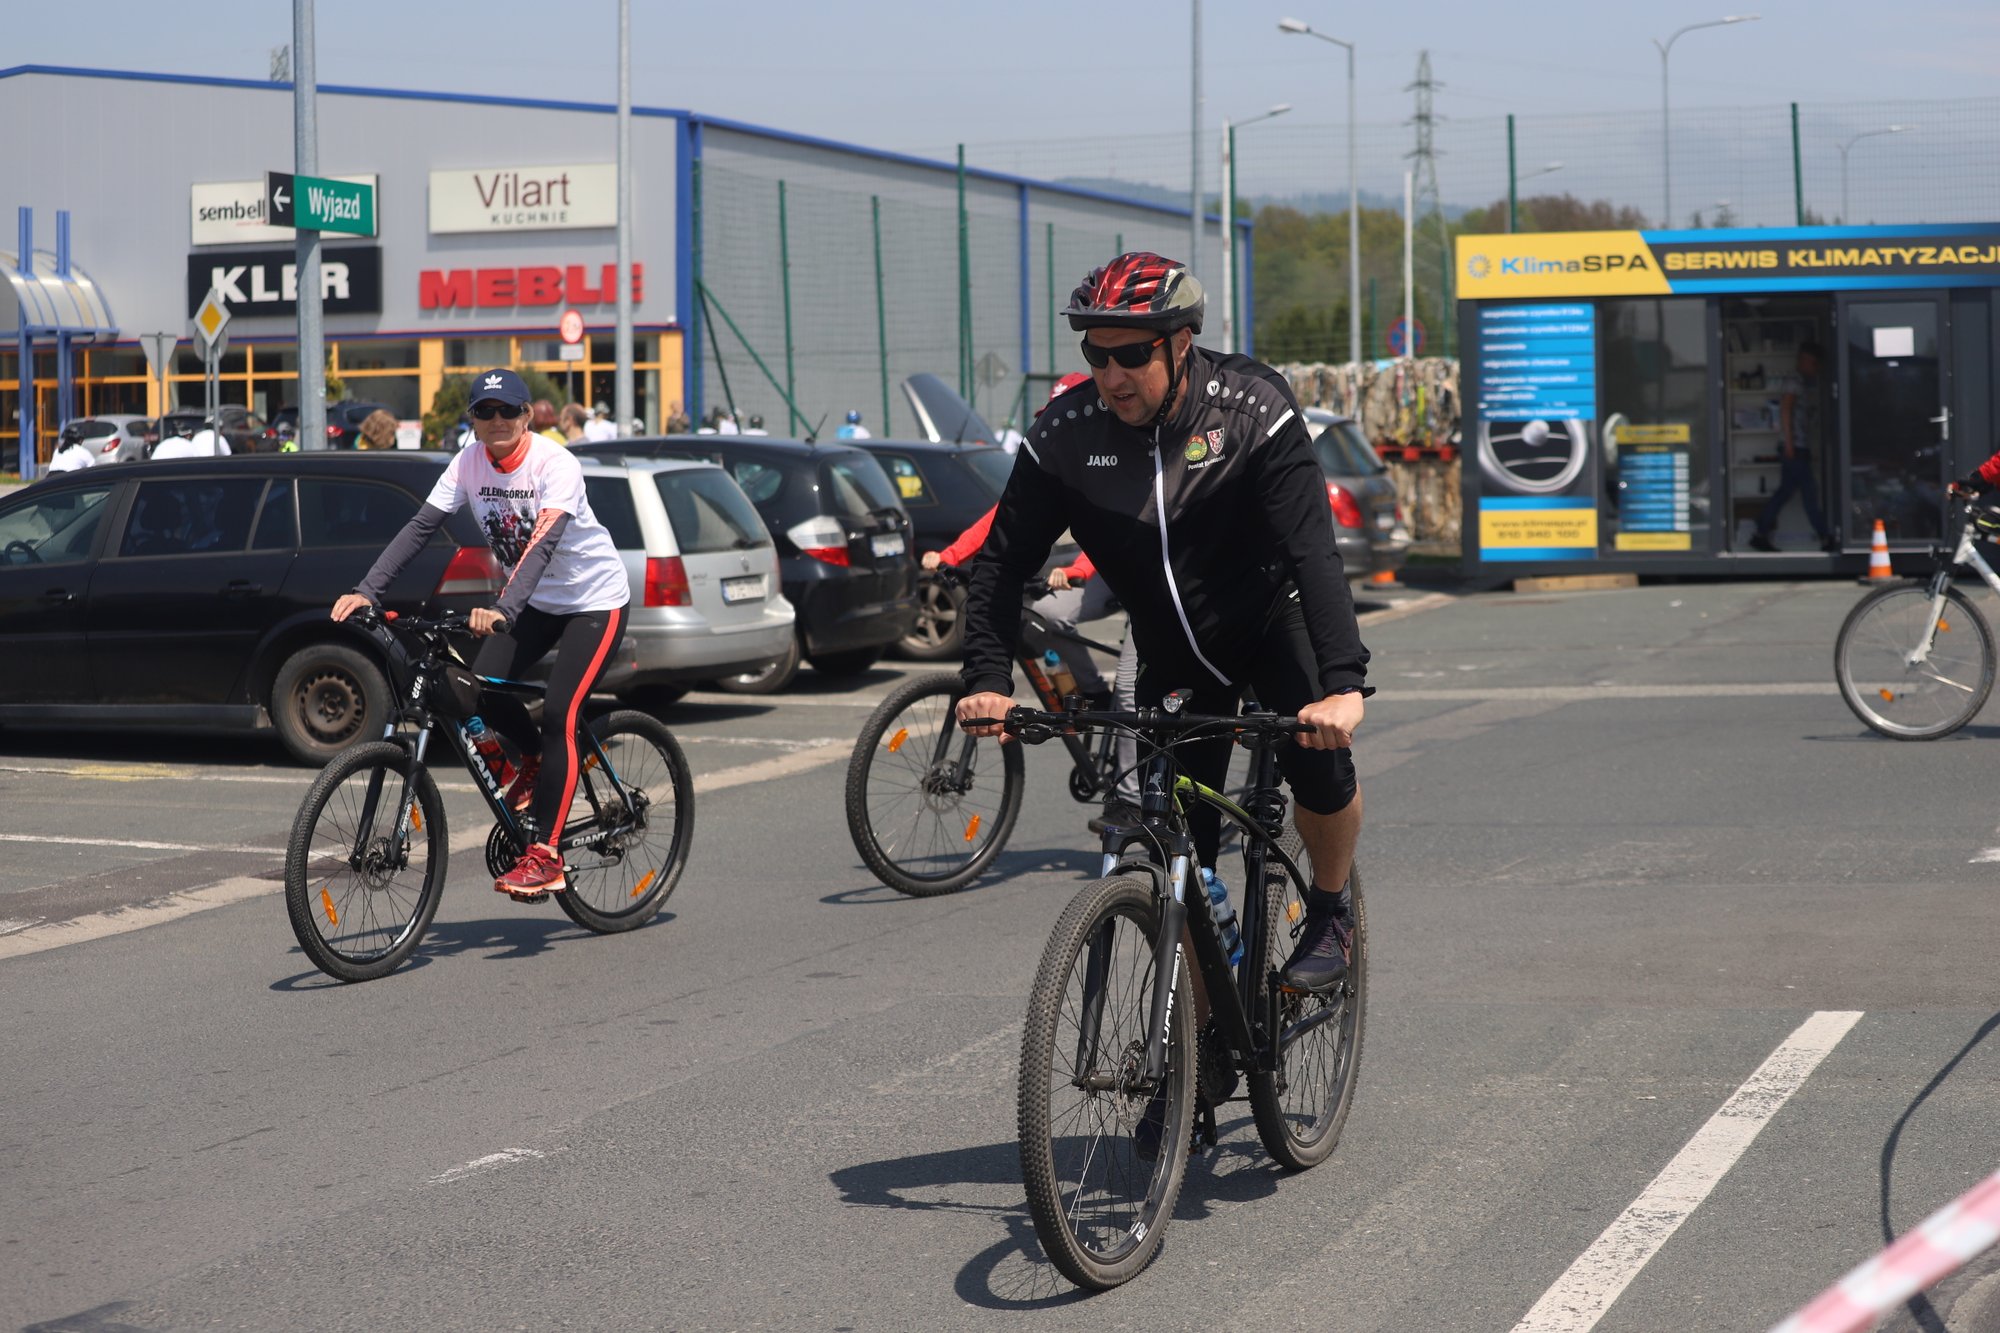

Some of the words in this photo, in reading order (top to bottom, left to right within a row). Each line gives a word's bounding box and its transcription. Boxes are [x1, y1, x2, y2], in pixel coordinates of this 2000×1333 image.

[474, 173, 571, 208] Vilart
[308, 186, 361, 223] Wyjazd
[491, 211, 568, 225] KUCHNIE
[1500, 254, 1649, 275] KlimaSPA
[1664, 250, 1779, 271] SERWIS
[211, 262, 350, 304] KLER
[419, 262, 644, 310] MEBLE
[1086, 455, 1118, 467] JAKO
[572, 830, 607, 848] GIANT
